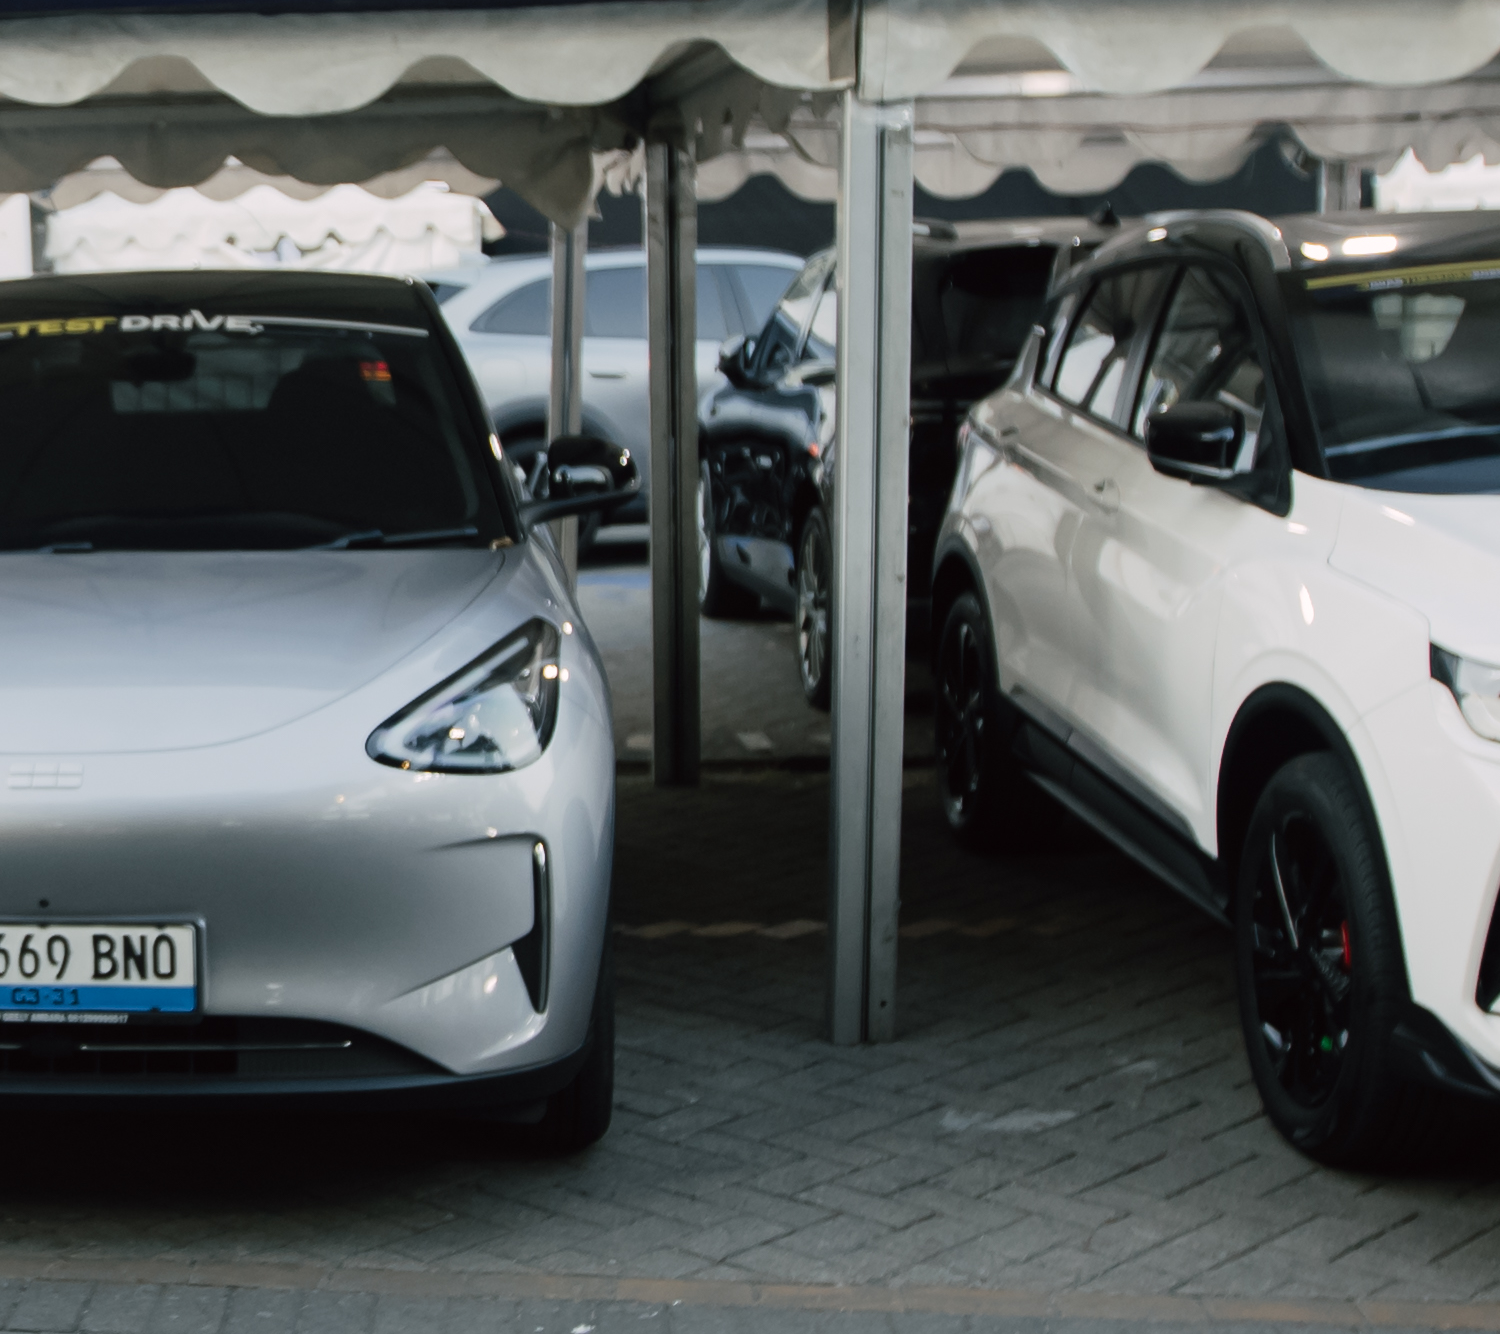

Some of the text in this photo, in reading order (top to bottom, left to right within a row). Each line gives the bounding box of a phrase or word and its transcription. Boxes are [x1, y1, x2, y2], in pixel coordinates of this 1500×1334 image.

[12, 309, 252, 337] TEST DRIVE
[92, 933, 177, 981] BNO
